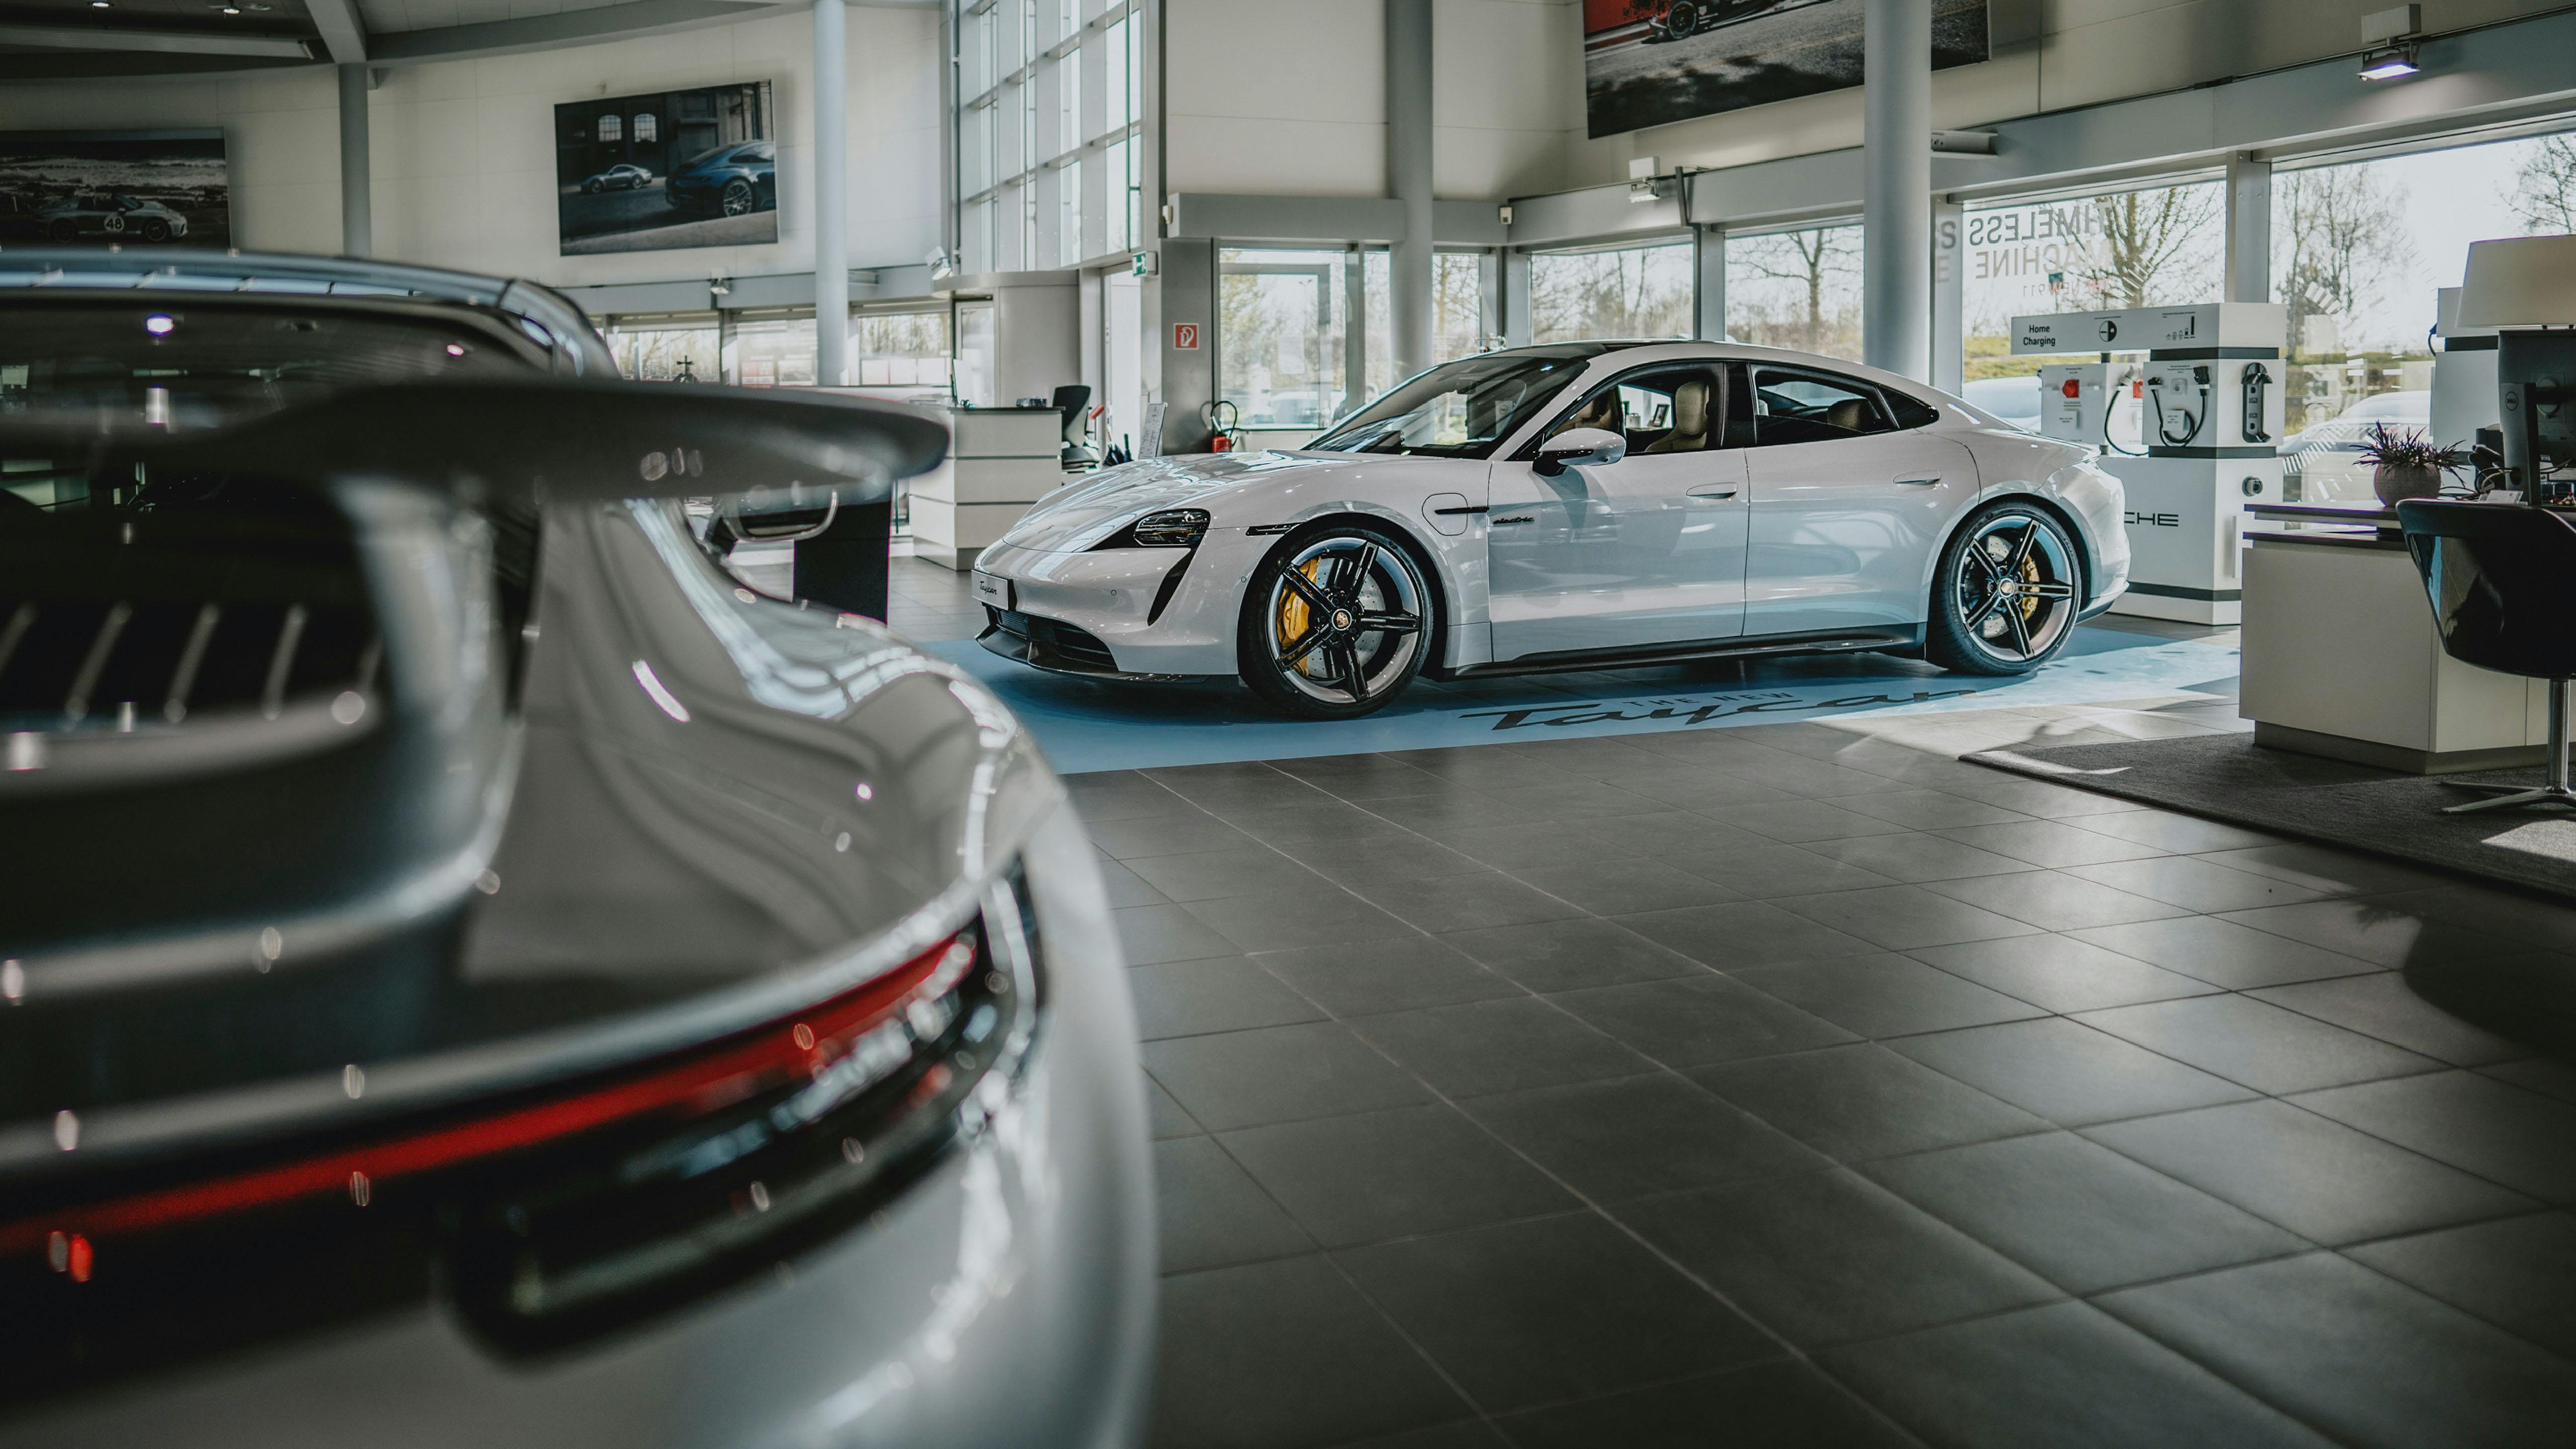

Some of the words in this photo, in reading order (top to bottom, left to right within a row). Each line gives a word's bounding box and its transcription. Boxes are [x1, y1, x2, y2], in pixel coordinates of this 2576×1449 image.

[106, 218, 122, 230] 48
[2029, 324, 2050, 333] Home
[2023, 336, 2055, 347] Charging
[980, 581, 997, 595] Taycan
[1622, 698, 1700, 707] THE
[1712, 692, 1794, 702] NEW
[1458, 689, 2004, 731] Taycan
